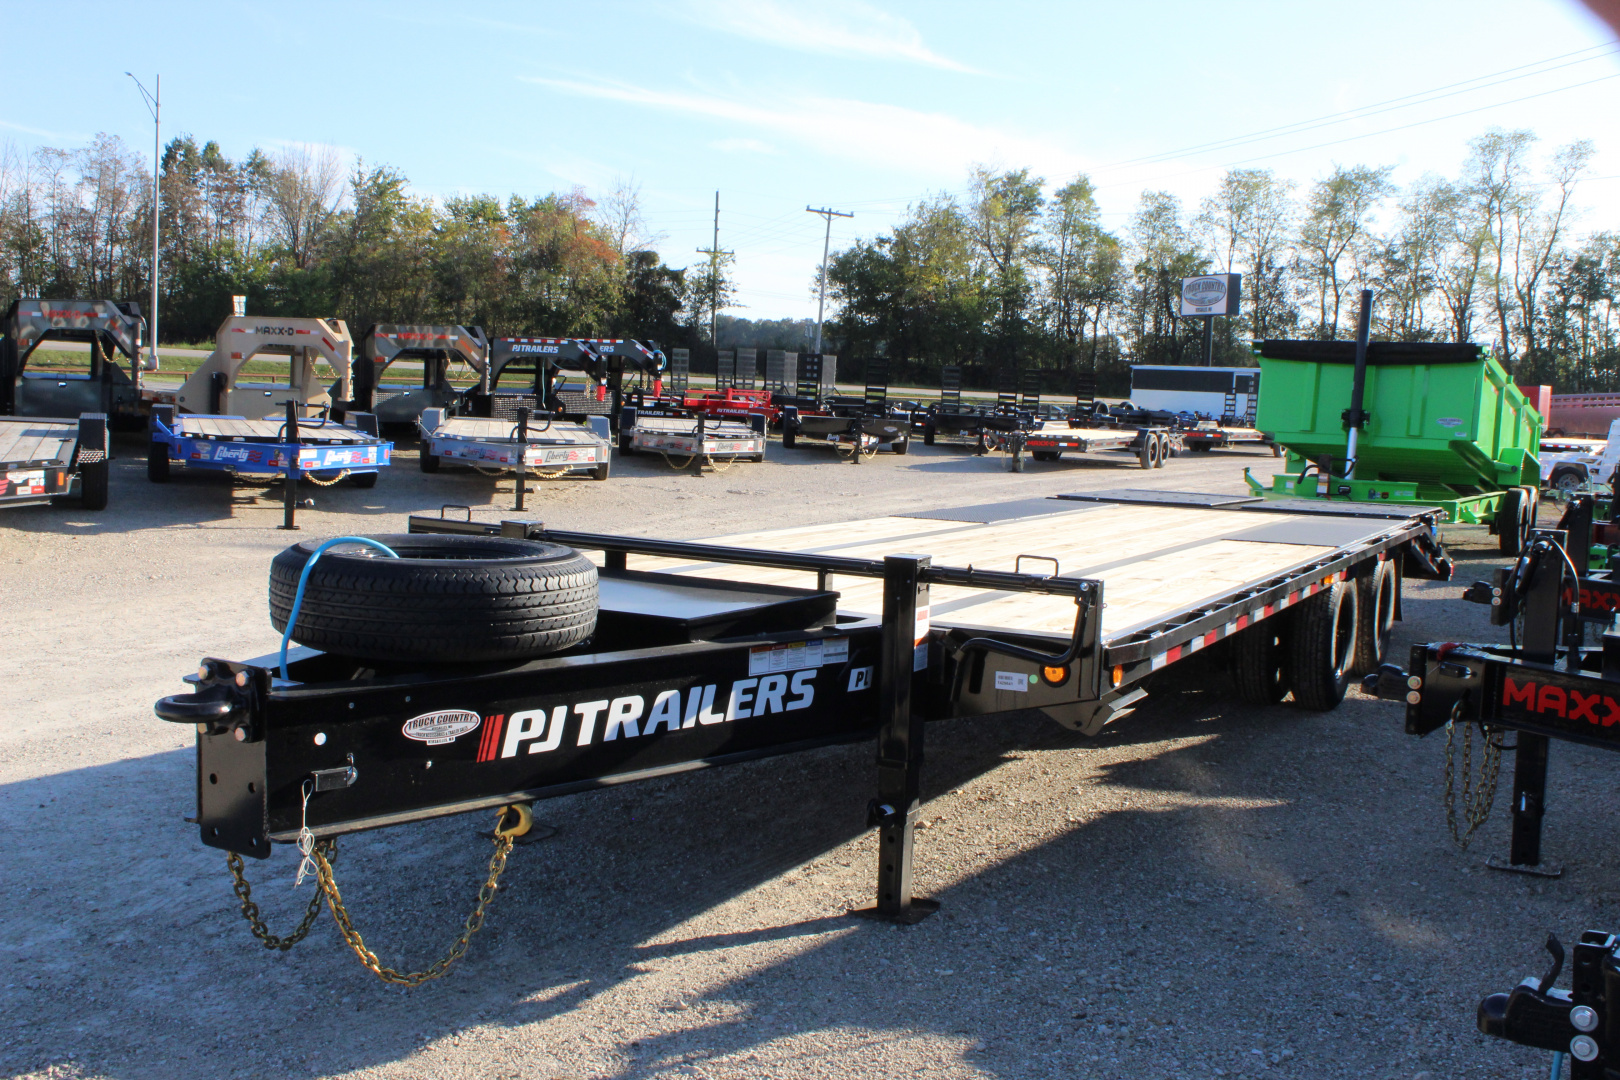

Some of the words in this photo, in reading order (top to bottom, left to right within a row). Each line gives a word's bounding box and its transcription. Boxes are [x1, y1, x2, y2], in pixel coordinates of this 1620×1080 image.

[43, 310, 81, 319] MAXX-D
[255, 326, 294, 336] MAXX-D
[398, 332, 434, 340] MAXX-D
[511, 344, 521, 352] PJ
[520, 345, 559, 353] TRAILERS
[213, 446, 249, 462] Liberty
[323, 450, 352, 465] Liberty
[545, 451, 570, 462] Liberty
[501, 705, 568, 759] PJ
[574, 669, 817, 746] TRAILERS
[408, 716, 436, 730] TRUCK
[437, 713, 475, 724] COUNTRY
